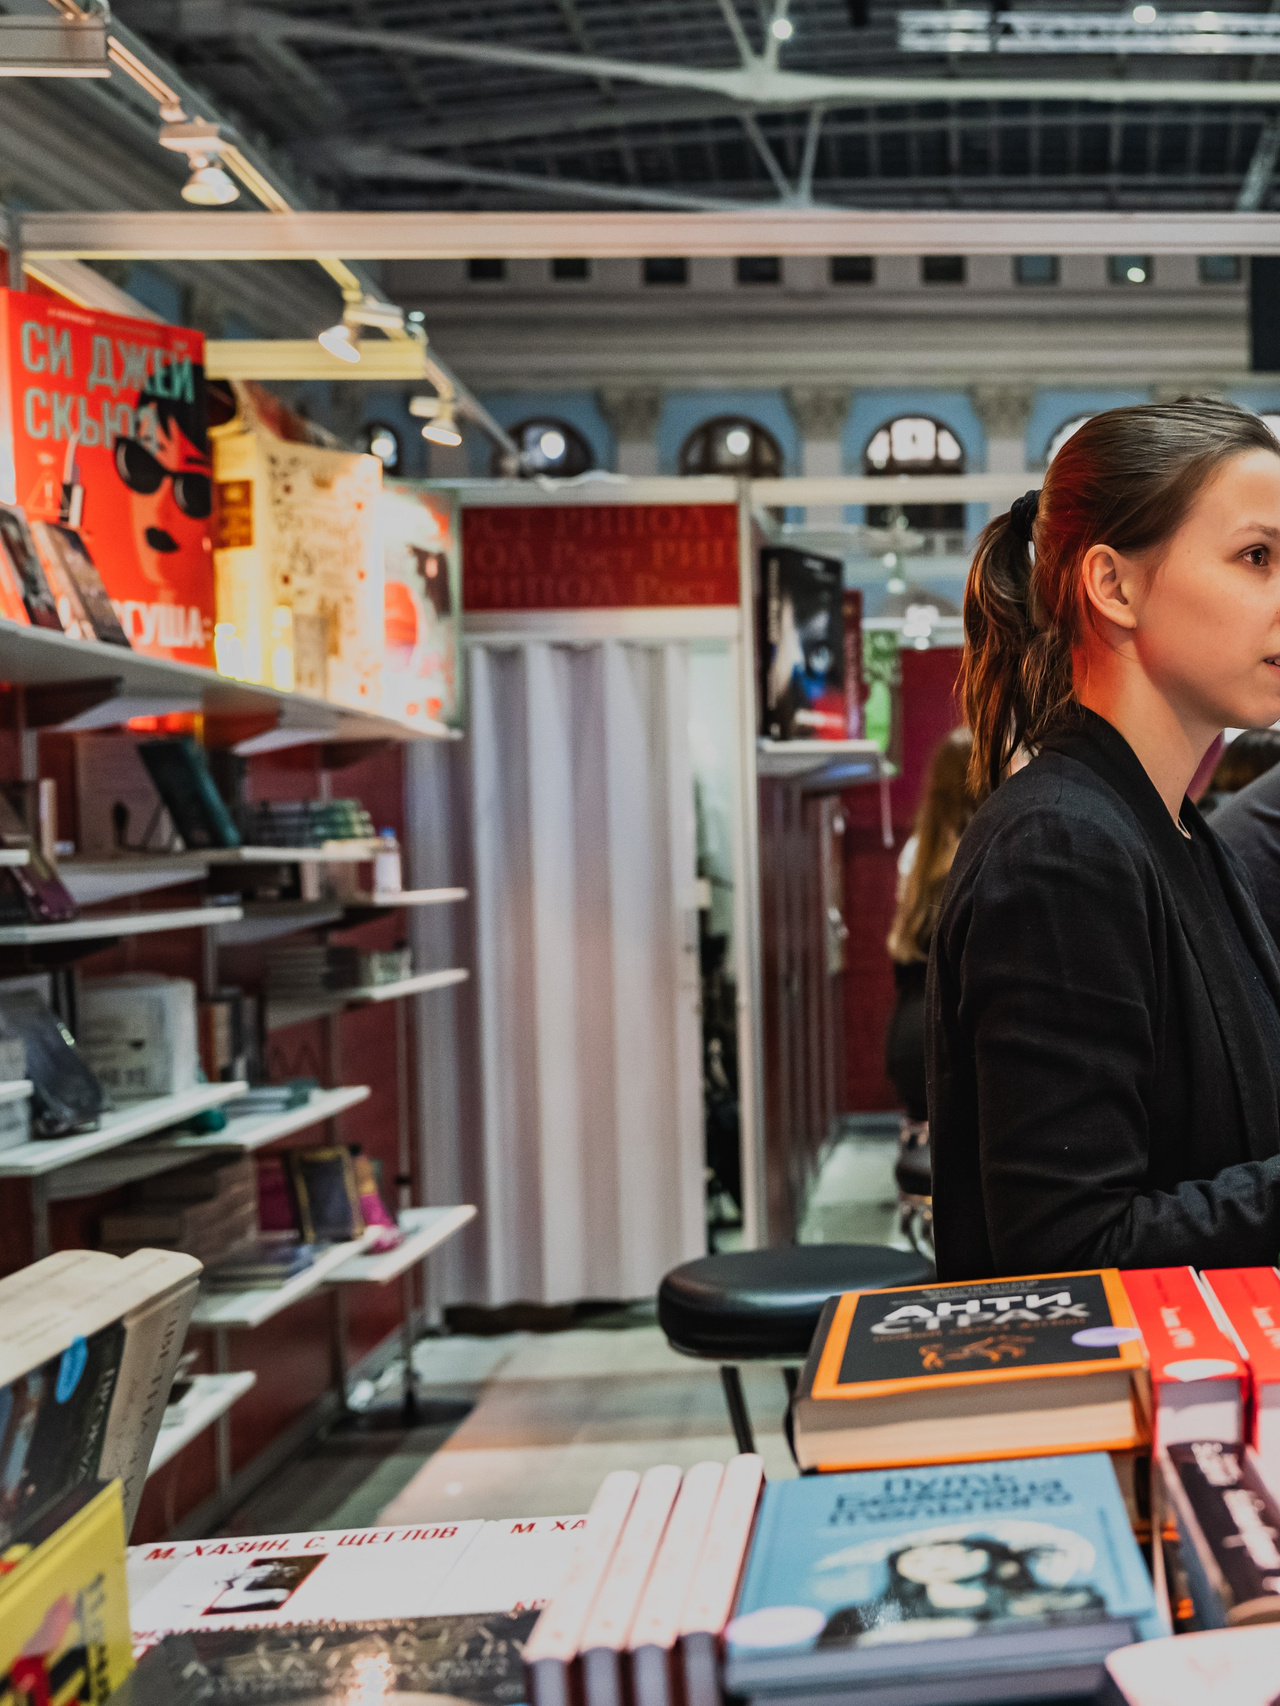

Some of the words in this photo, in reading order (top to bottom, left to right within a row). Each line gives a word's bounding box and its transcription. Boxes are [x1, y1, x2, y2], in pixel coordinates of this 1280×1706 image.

[21, 320, 73, 379] СИ
[87, 339, 195, 405] ДЖЕЙ
[871, 1303, 1090, 1335] СТРАХ
[884, 1291, 1073, 1322] АНТИ
[144, 1546, 175, 1561] М.
[304, 1535, 326, 1549] С.
[336, 1525, 459, 1547] ЩЕГЛОВ
[510, 1522, 540, 1534] М.
